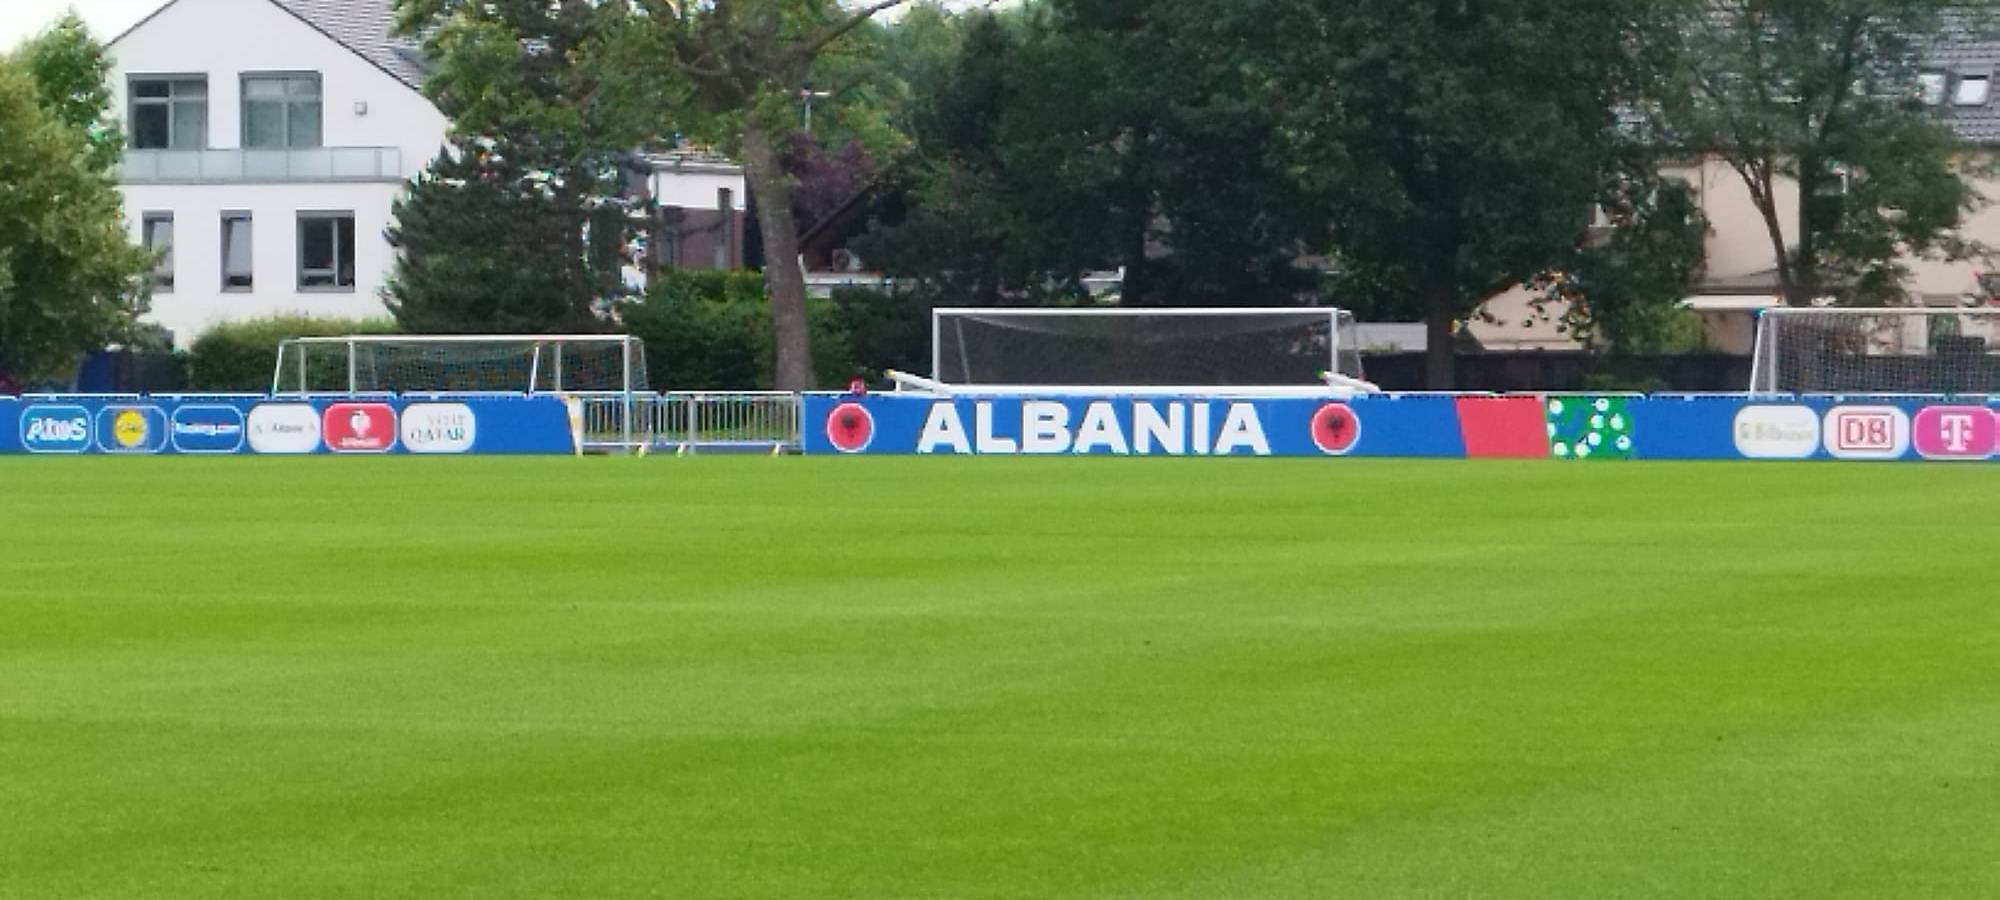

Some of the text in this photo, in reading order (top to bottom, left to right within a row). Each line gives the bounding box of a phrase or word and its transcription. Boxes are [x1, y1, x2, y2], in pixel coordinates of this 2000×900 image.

[917, 401, 1273, 455] ALBANIA
[1846, 418, 1887, 444] DB
[1940, 415, 1973, 451] T
